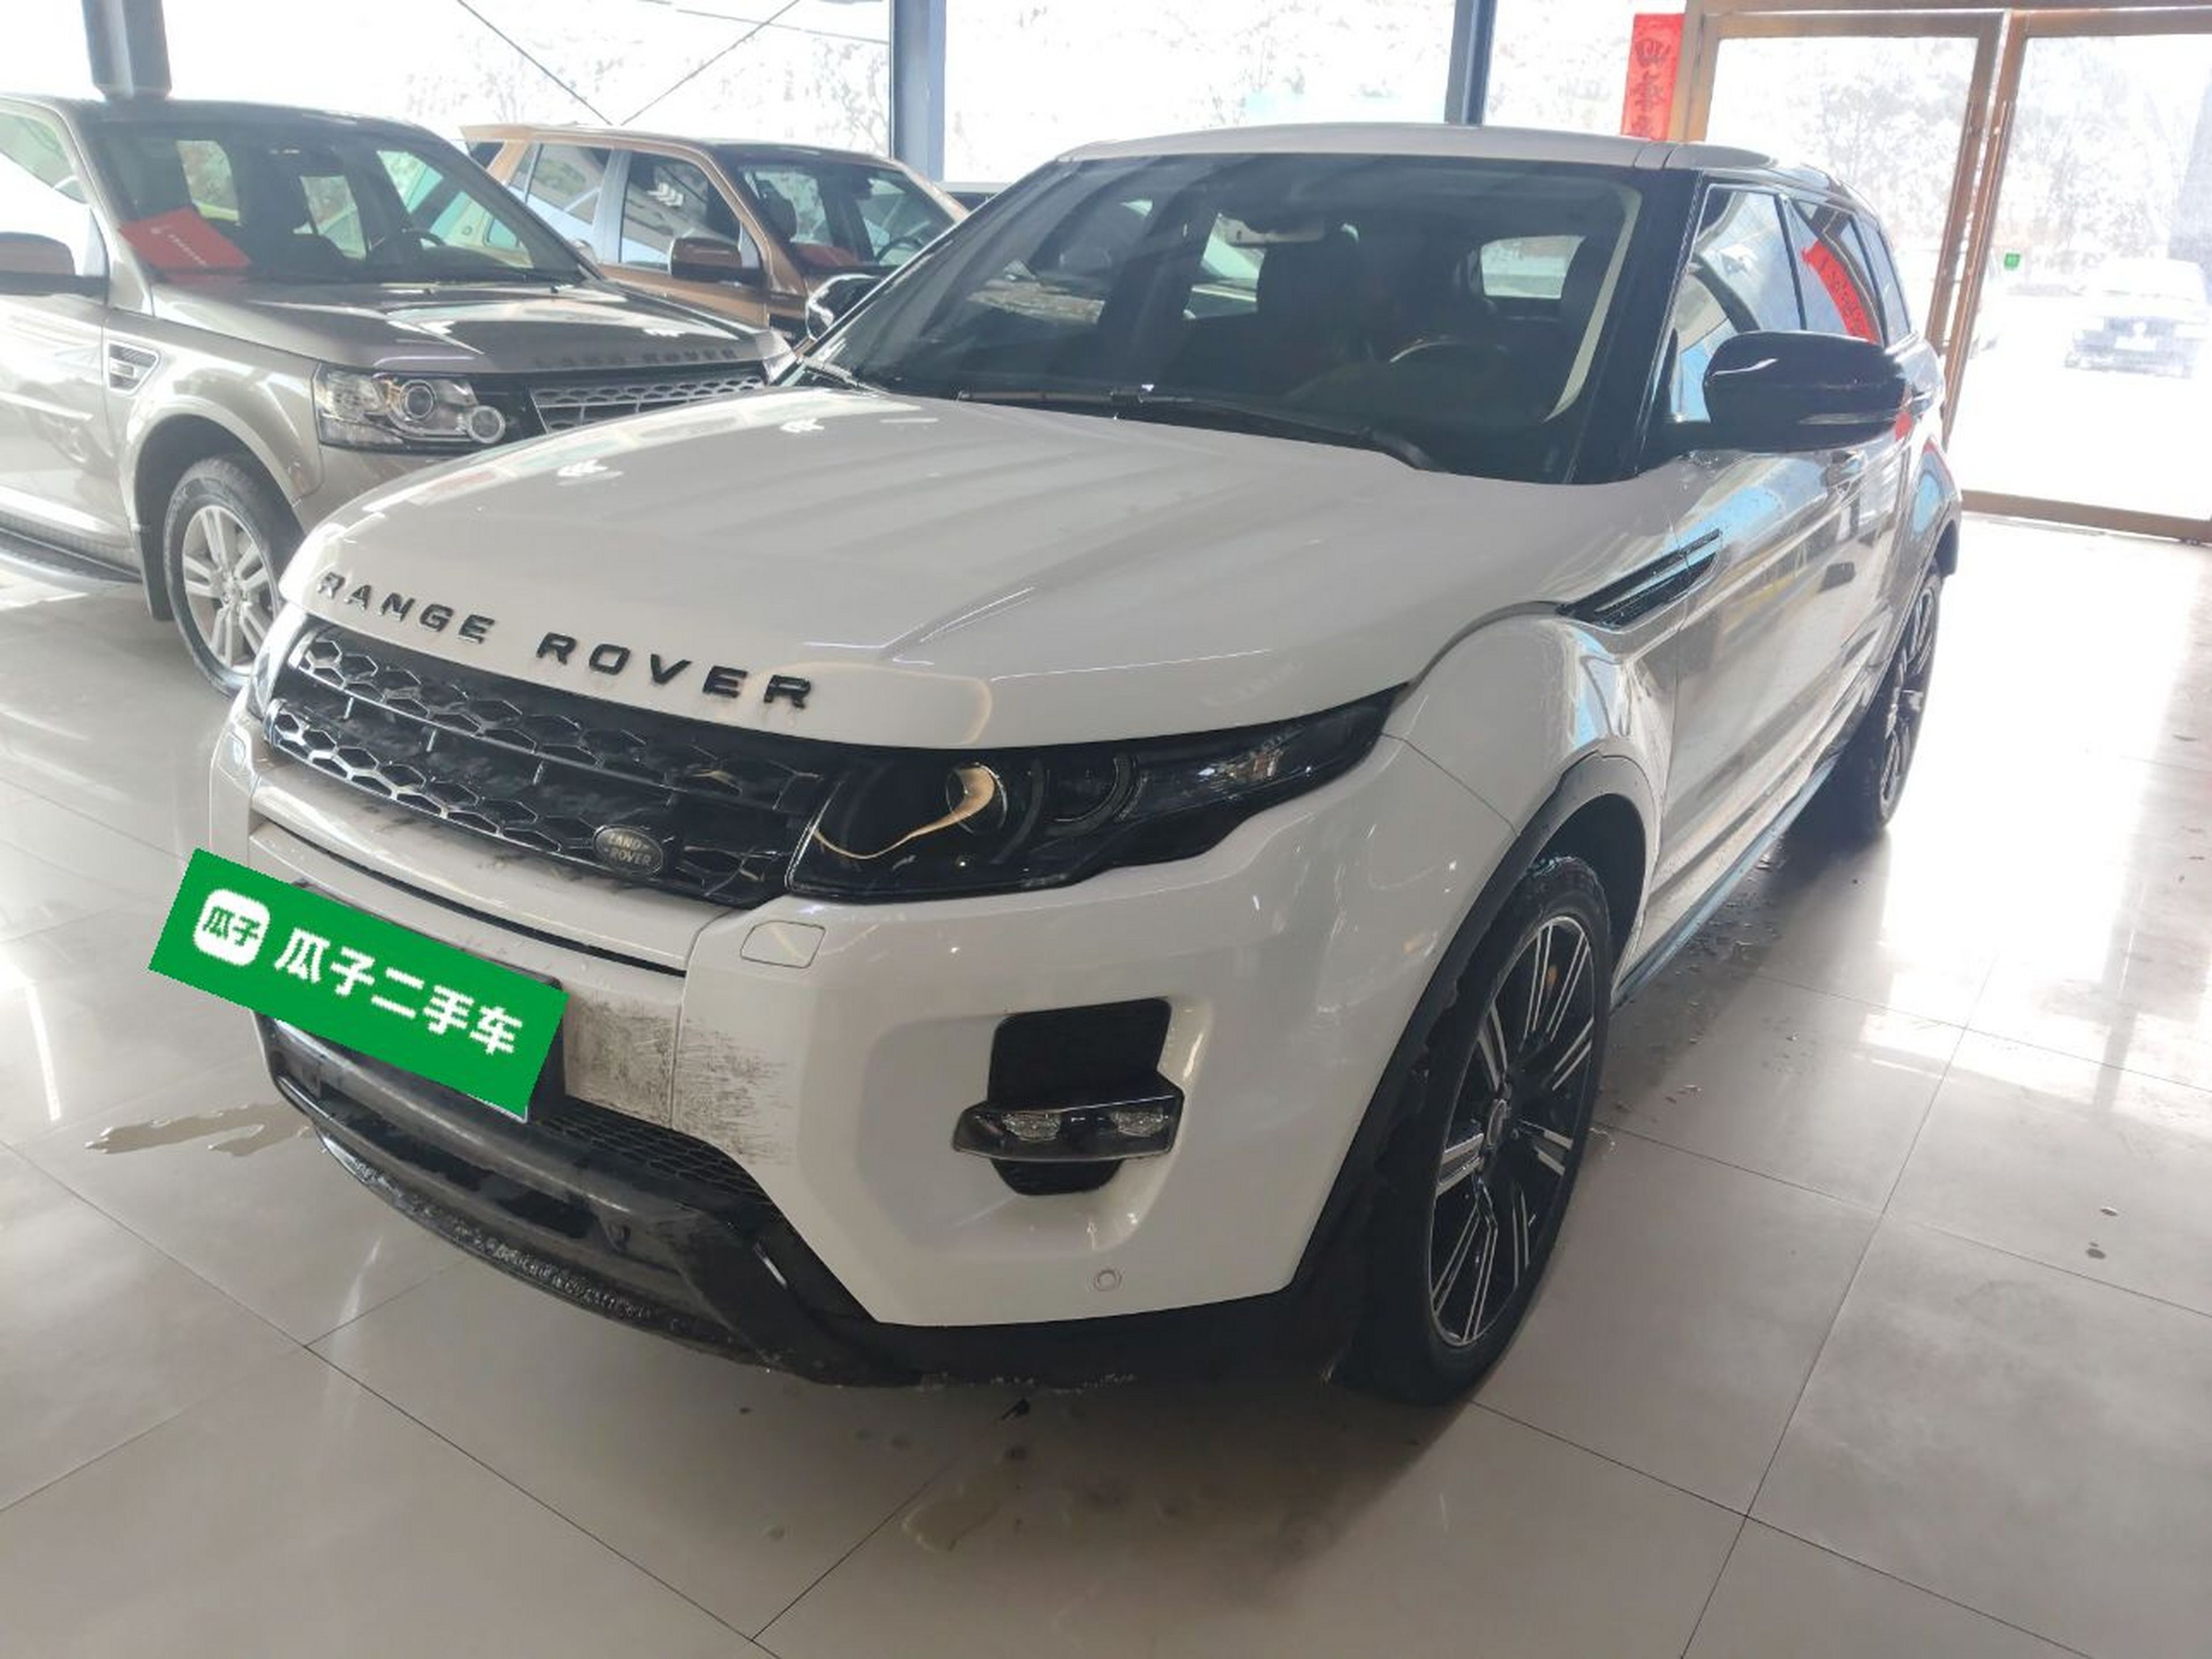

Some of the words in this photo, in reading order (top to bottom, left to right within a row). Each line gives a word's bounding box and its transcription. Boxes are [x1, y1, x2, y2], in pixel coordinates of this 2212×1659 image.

[316, 571, 495, 645] RANGE
[536, 631, 812, 708] ROVER
[608, 832, 642, 850] LAND
[609, 847, 652, 866] ROVER
